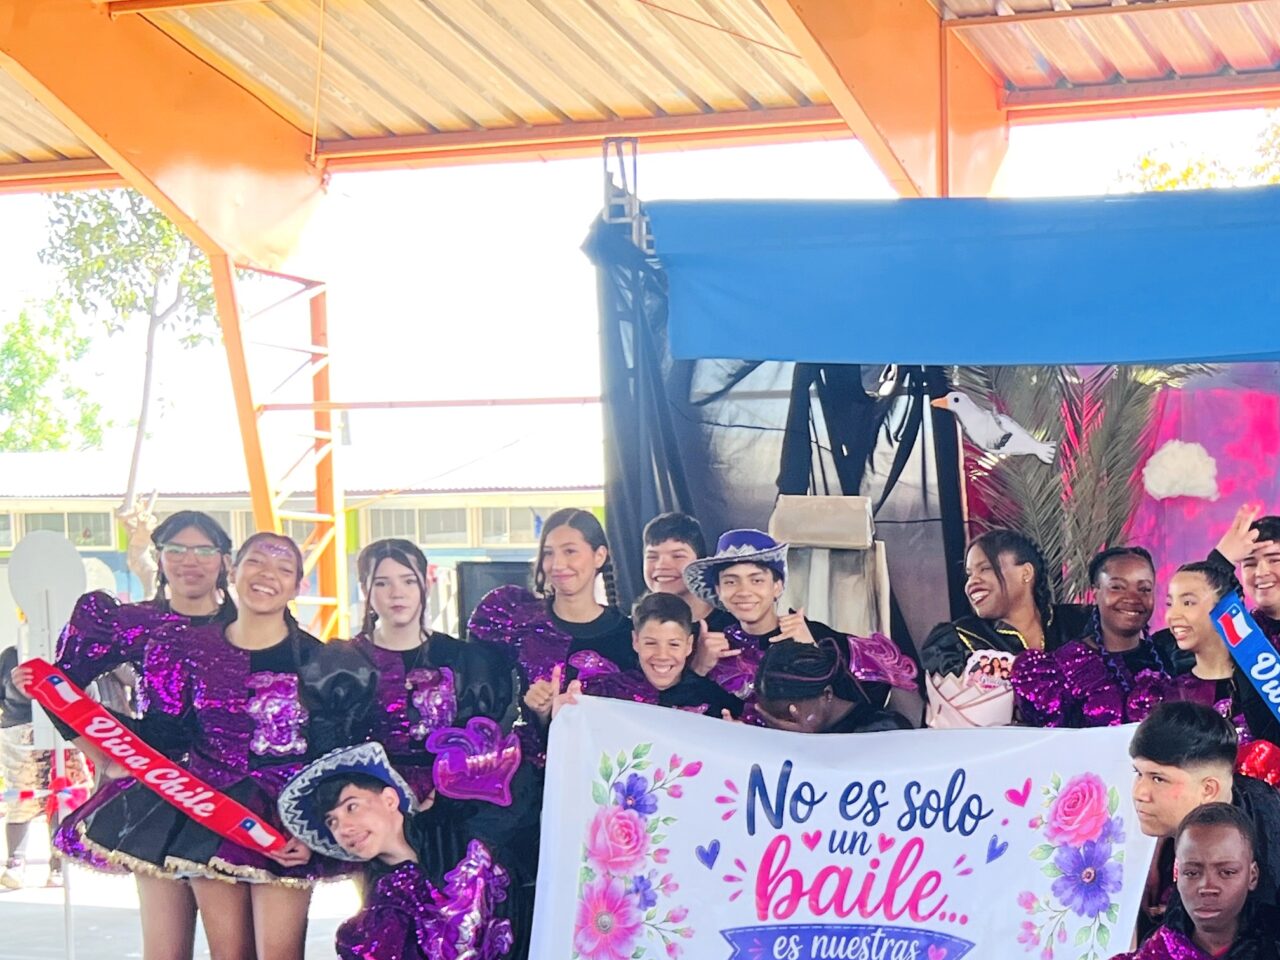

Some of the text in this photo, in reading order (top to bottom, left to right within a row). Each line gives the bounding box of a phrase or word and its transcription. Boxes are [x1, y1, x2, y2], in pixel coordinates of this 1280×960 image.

[85, 716, 215, 818] Viva Chile
[746, 759, 994, 837] No es solo
[755, 834, 969, 926] baile...
[828, 829, 873, 857] un
